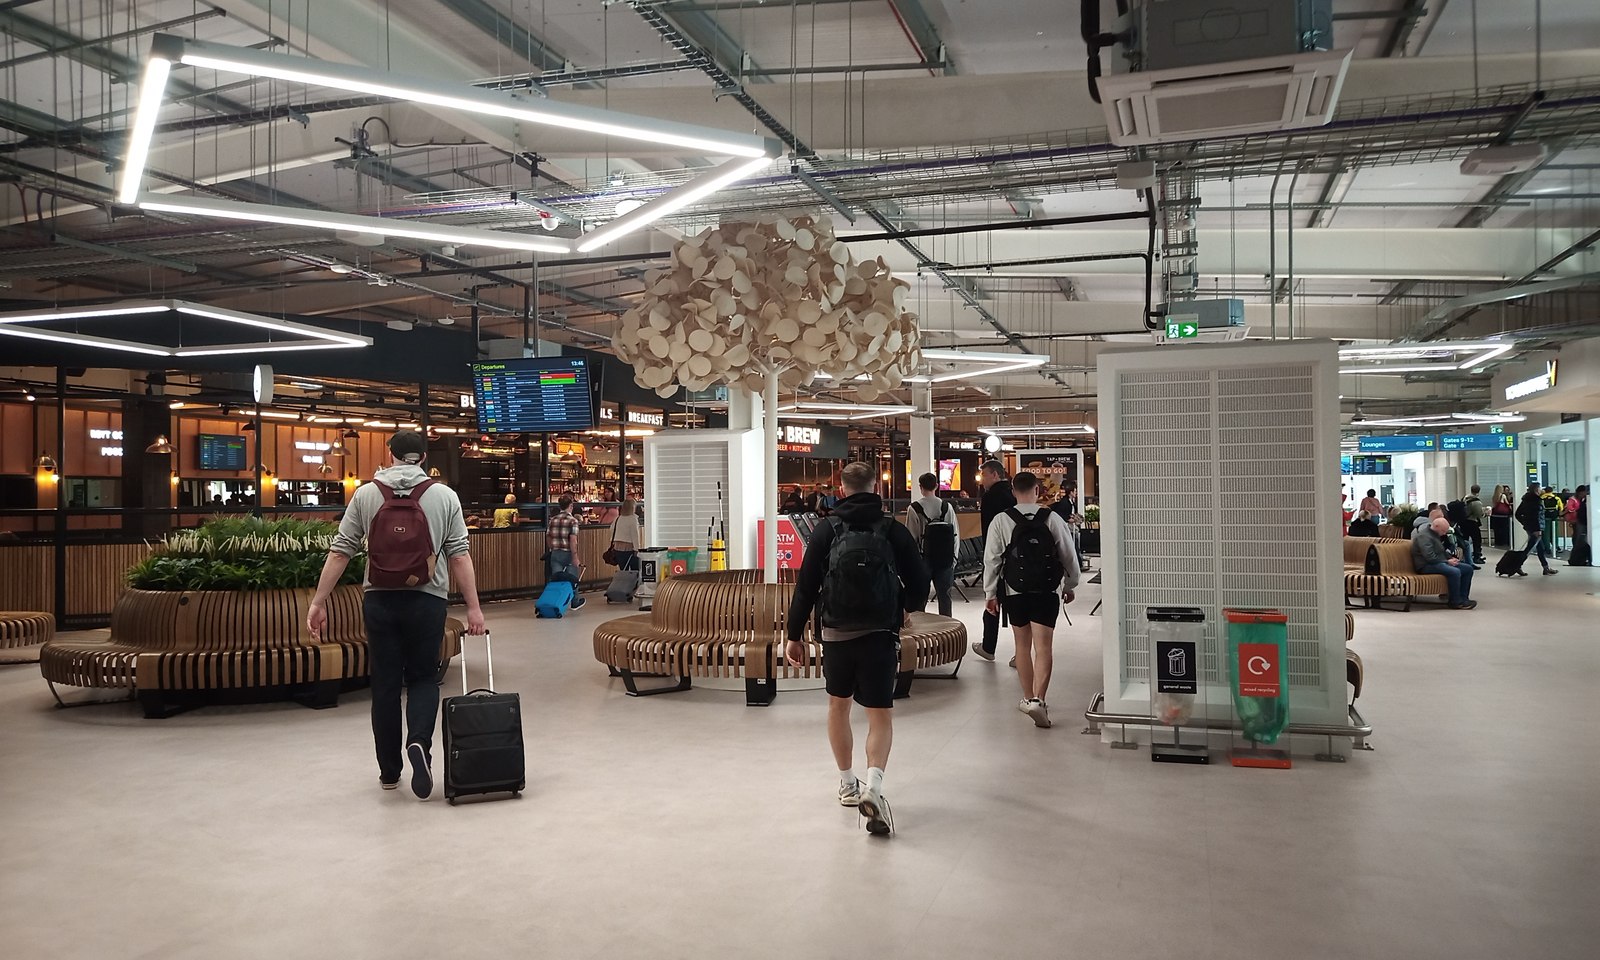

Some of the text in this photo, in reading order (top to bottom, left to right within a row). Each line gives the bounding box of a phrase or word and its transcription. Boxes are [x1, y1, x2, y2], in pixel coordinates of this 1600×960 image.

[628, 411, 664, 426] BREAKFAST
[786, 426, 820, 444] BREW
[776, 534, 794, 542] ATM
